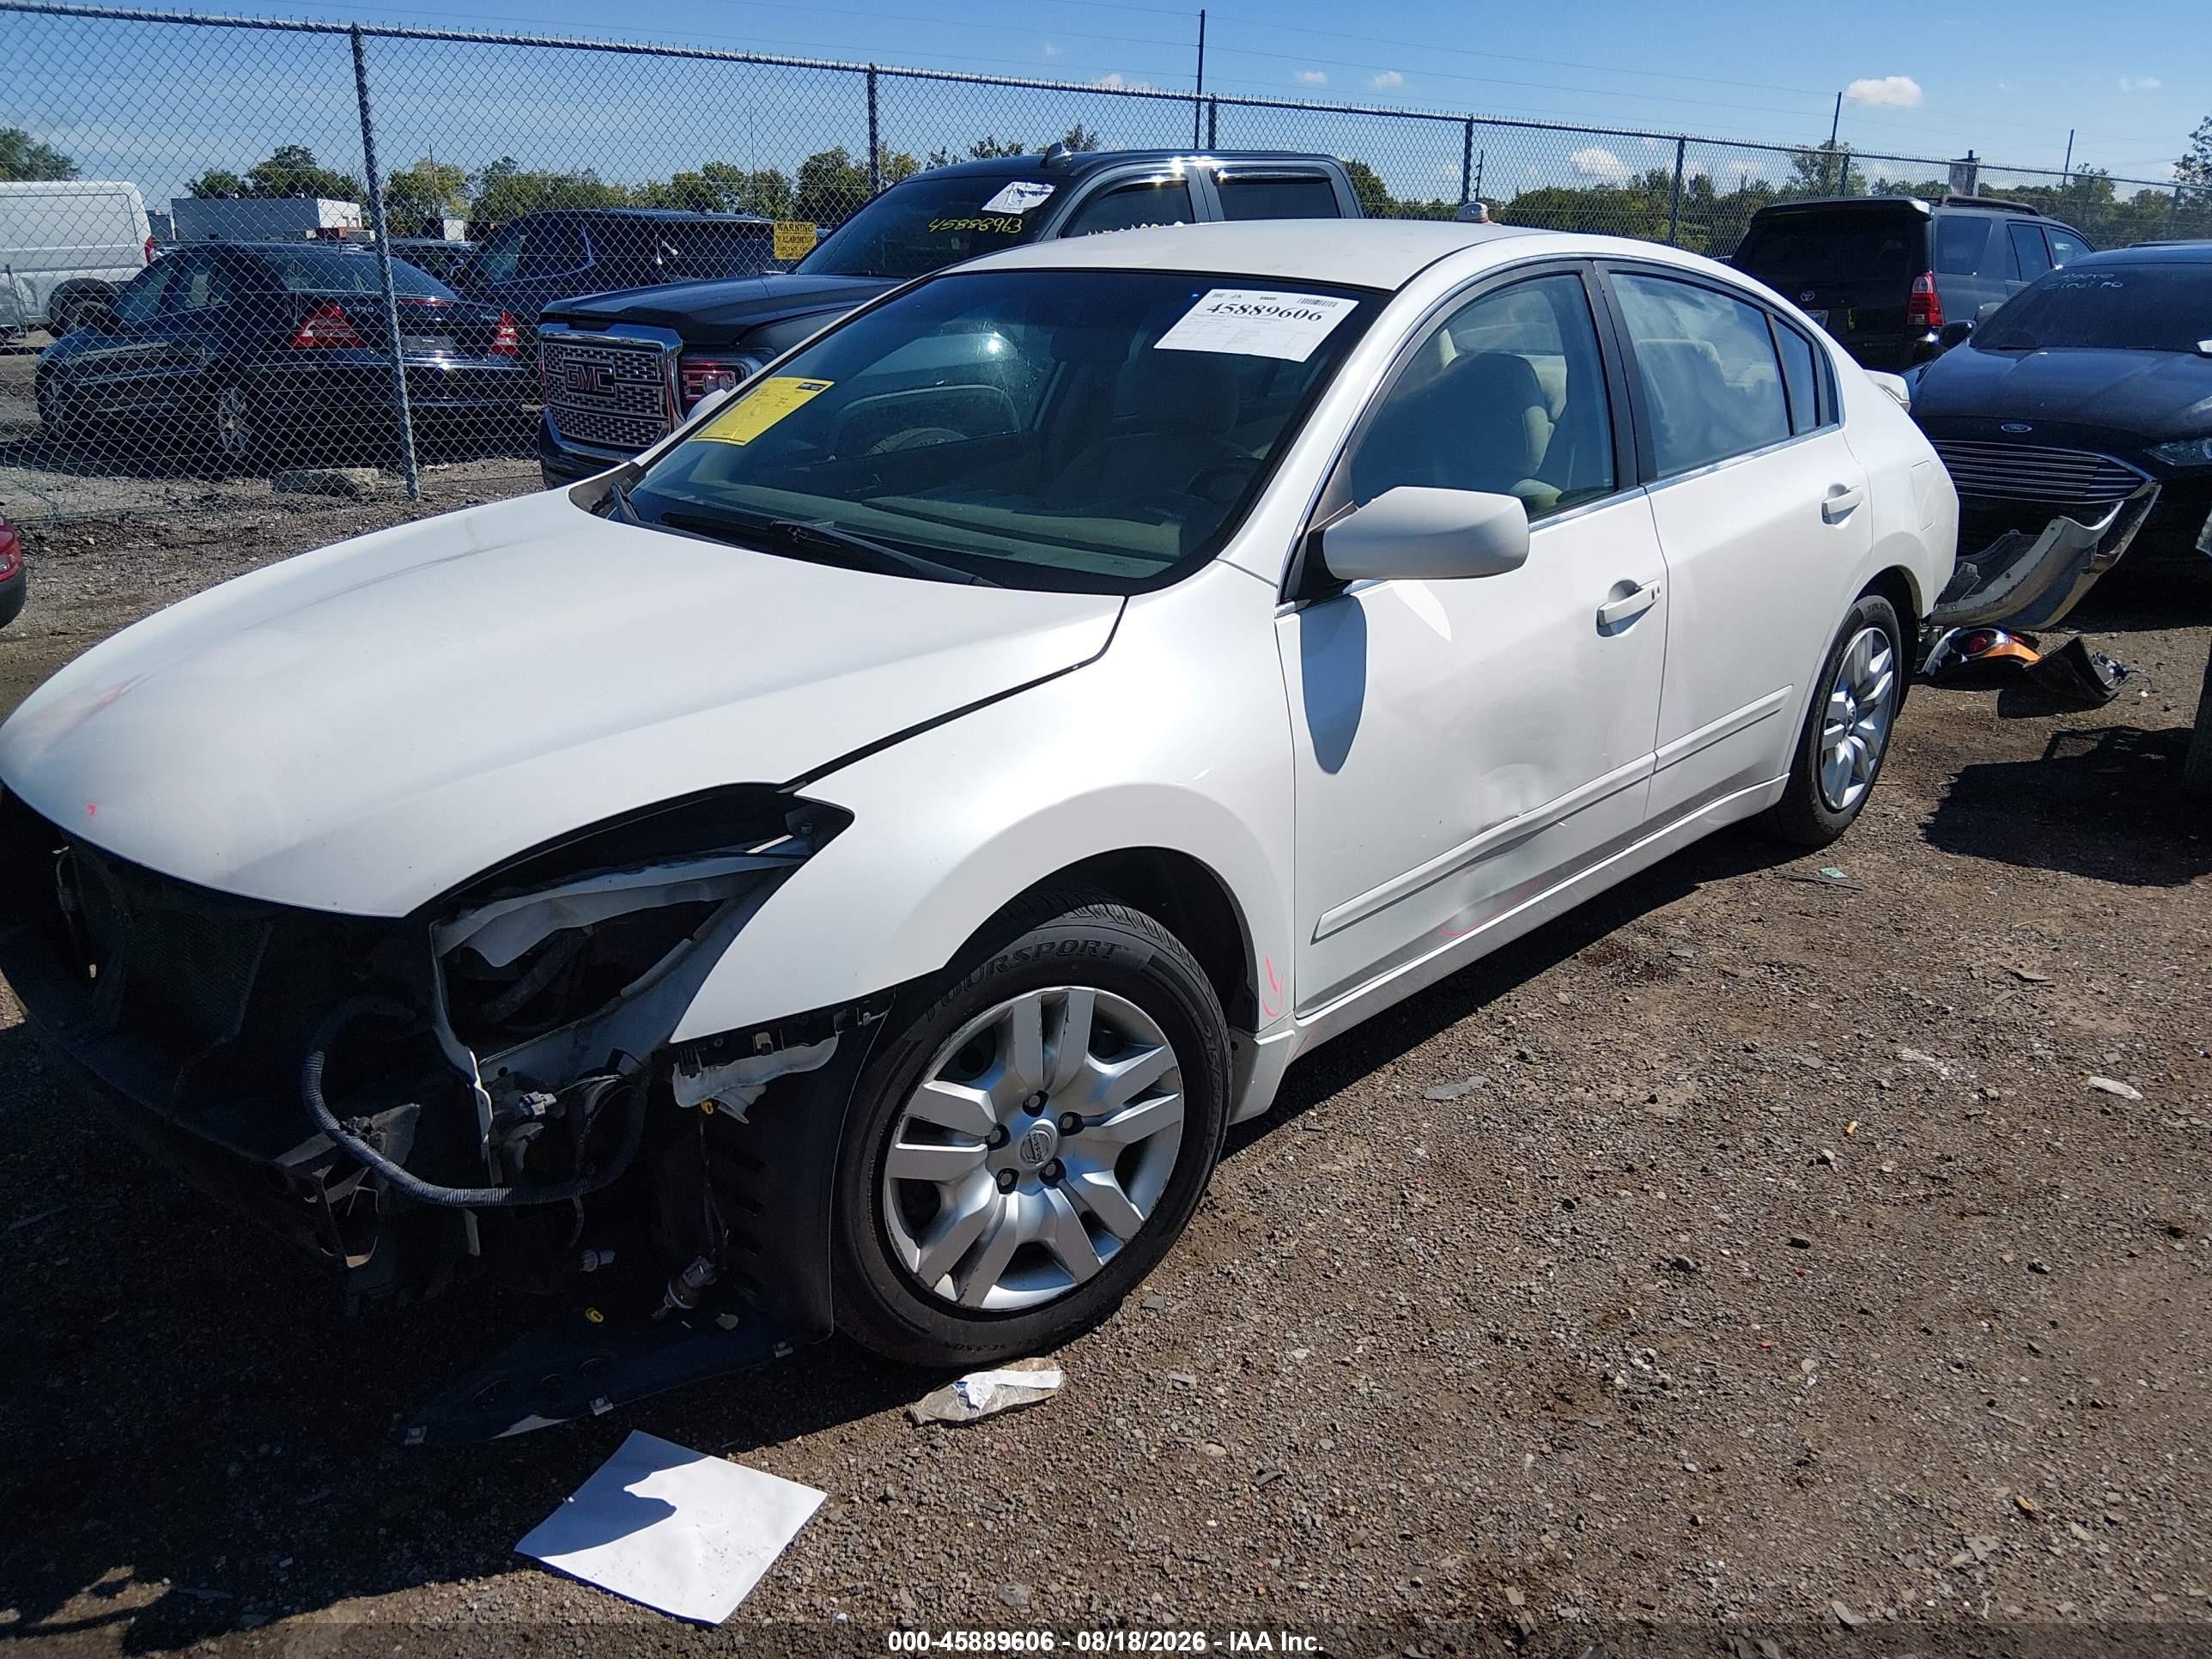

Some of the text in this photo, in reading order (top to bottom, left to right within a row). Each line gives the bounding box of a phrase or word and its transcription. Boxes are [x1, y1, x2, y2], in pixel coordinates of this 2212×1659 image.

[777, 223, 813, 232] WARNING
[928, 216, 1023, 234] 45888963
[1206, 302, 1327, 323] 45889606
[564, 362, 614, 393] GMC
